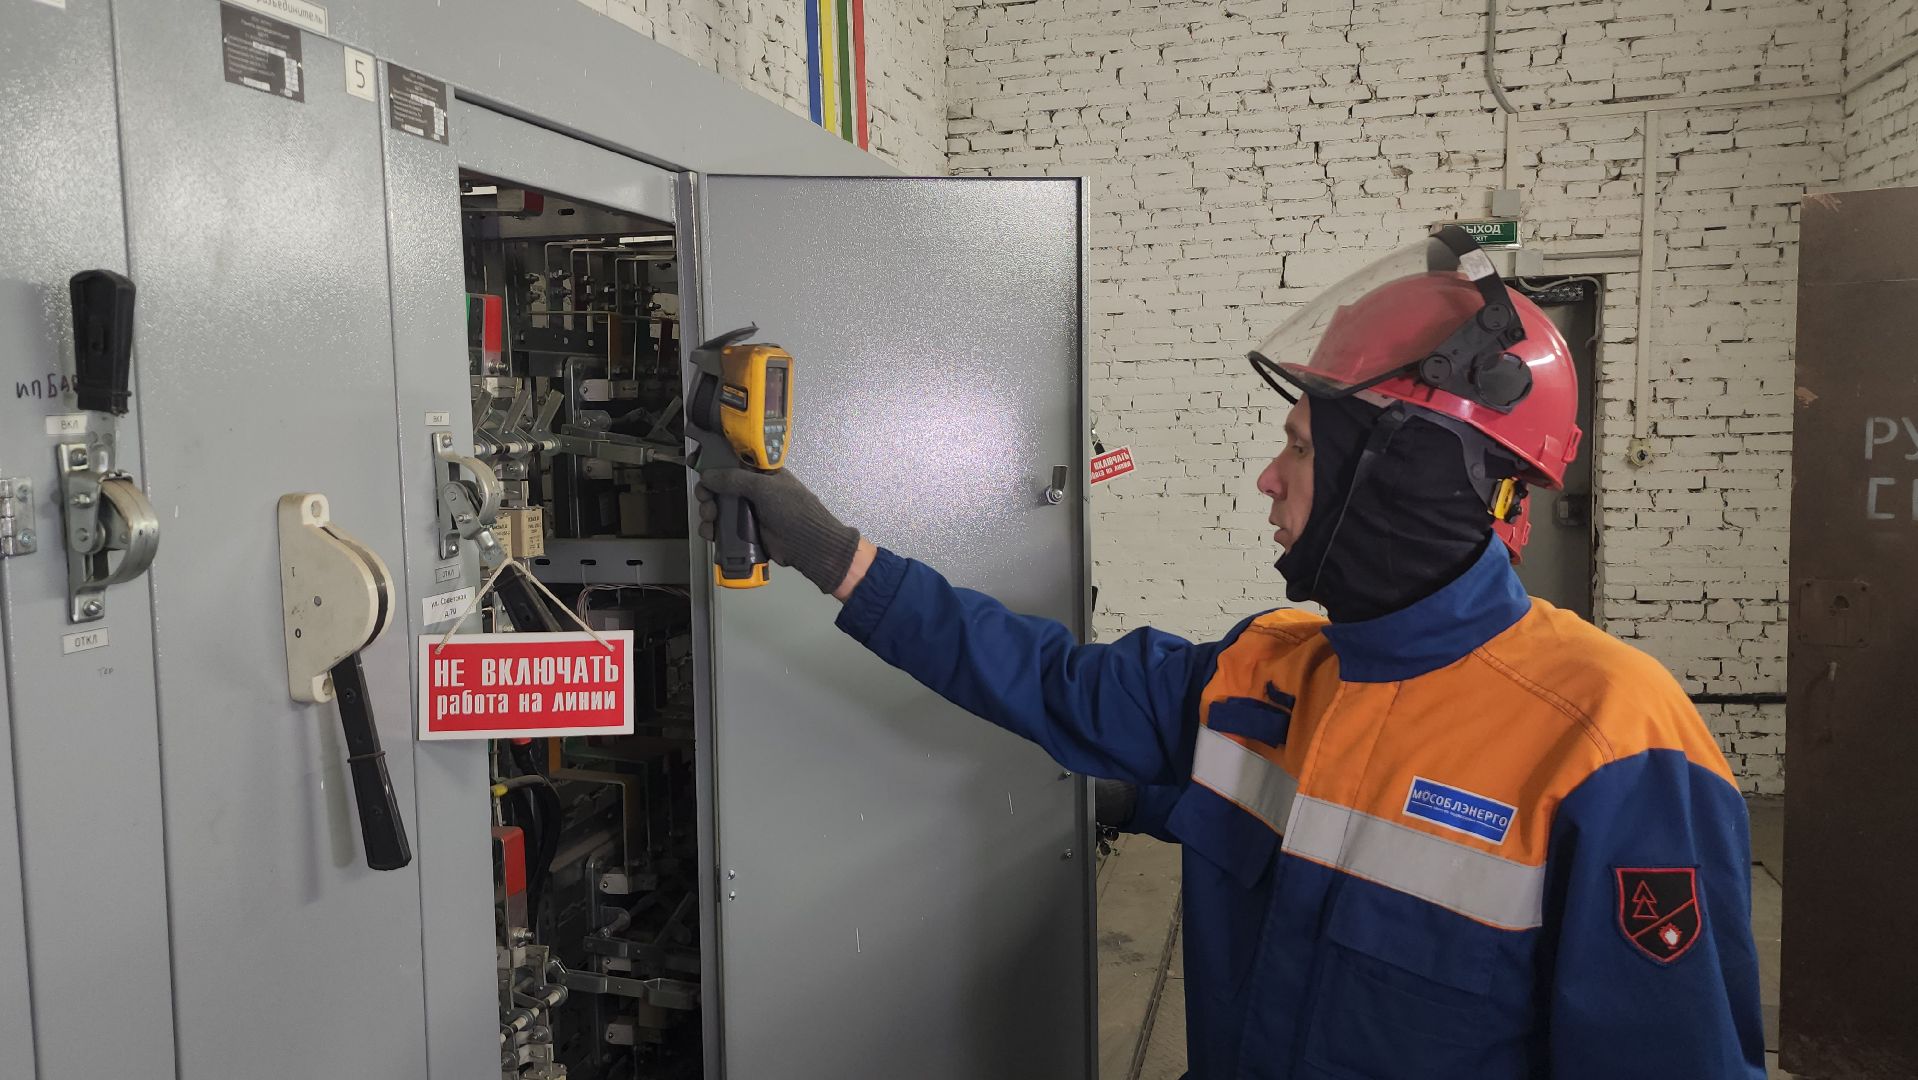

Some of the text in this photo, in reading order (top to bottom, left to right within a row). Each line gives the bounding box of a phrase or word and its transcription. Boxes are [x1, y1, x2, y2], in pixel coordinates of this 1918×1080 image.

[355, 59, 366, 89] 5
[60, 419, 79, 430] ВКЛ
[74, 633, 98, 648] ОТКЛ
[434, 655, 619, 687] НЕ ВКЛЮЧАТЬ
[436, 689, 617, 720] работа на линии
[1412, 789, 1508, 827] МОСОБЛЭНЕРГО
